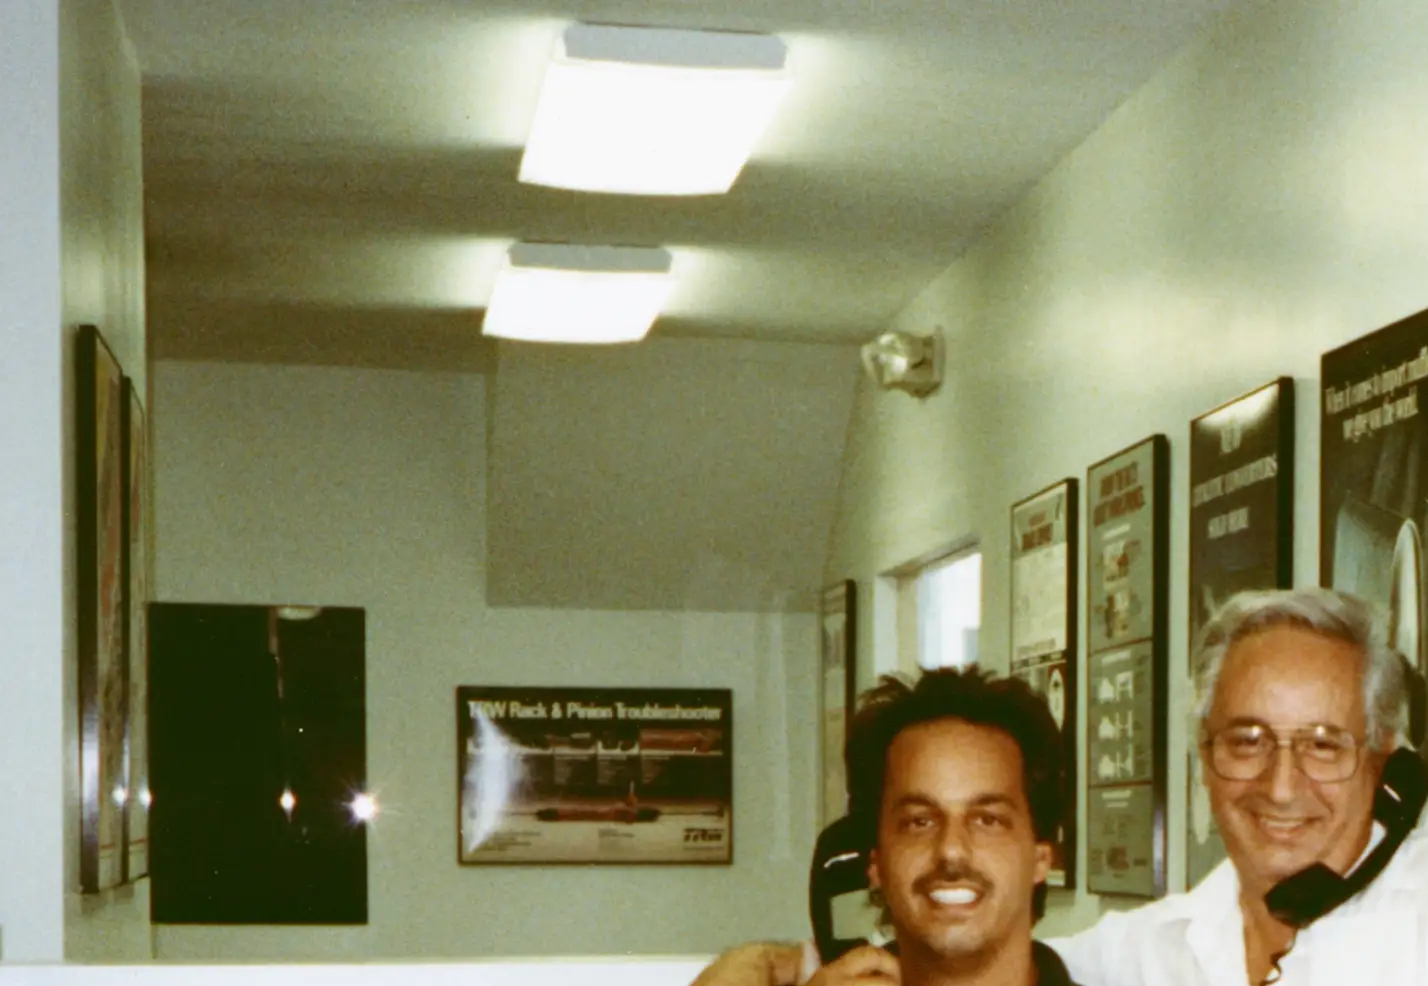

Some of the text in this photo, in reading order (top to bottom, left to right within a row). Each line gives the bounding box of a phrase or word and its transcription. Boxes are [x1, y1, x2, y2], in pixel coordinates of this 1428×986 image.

[509, 700, 548, 719] Rack
[551, 701, 563, 719] &
[567, 701, 613, 719] Pinion
[614, 701, 722, 720] Troubleshooter
